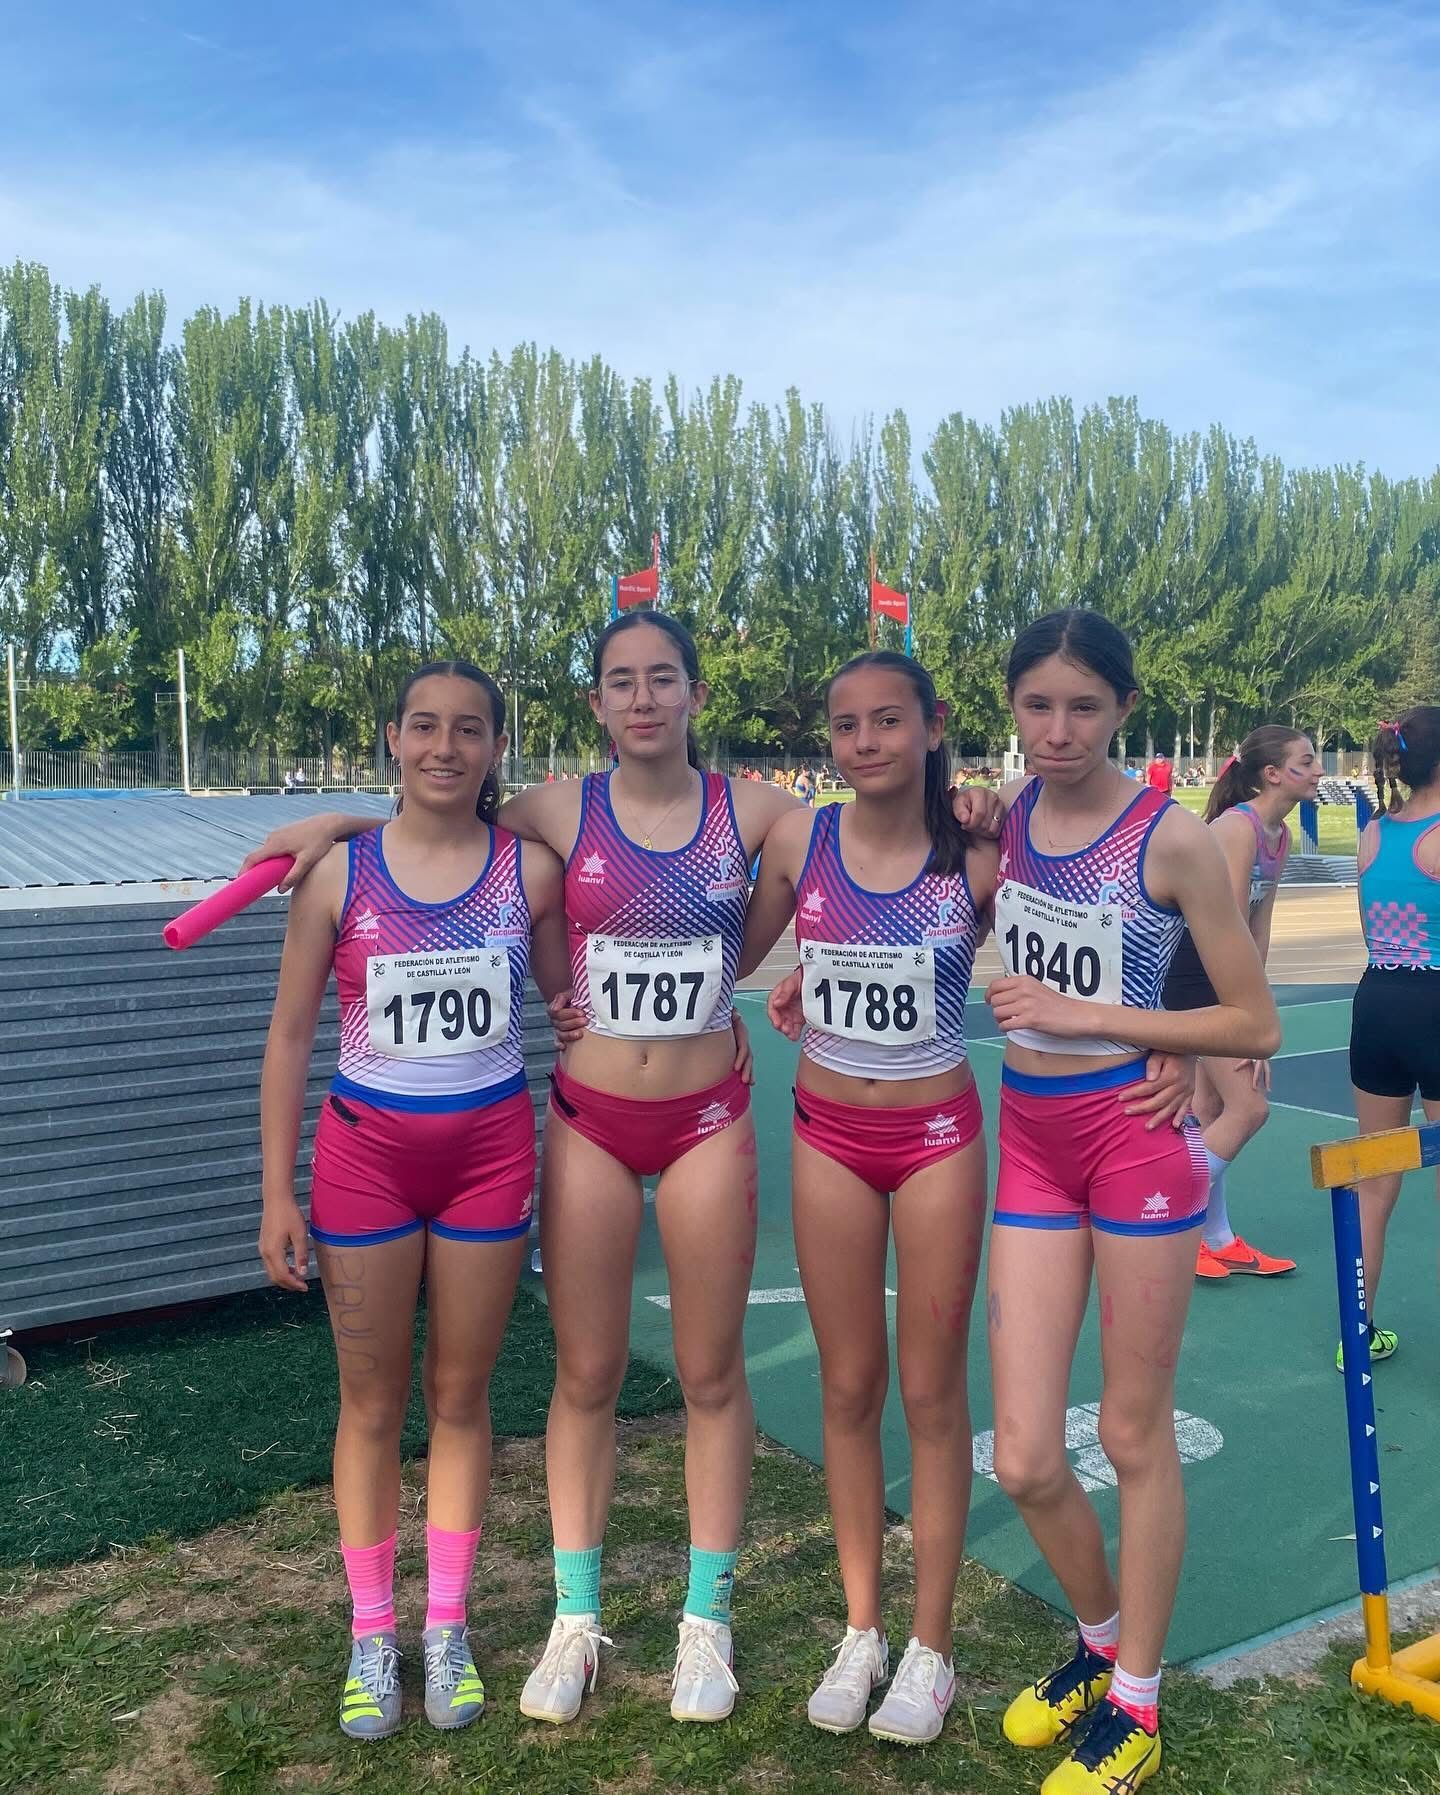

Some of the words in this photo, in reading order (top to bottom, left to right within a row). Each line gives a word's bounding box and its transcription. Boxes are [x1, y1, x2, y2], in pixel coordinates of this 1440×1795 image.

[577, 875, 605, 885] luanvi
[1017, 890, 1047, 909] FEDERACIÓN
[1047, 902, 1054, 911] DE
[1054, 906, 1088, 919] ATLETISMO
[1023, 905, 1031, 913] DE
[1031, 907, 1055, 923] CASTILLA
[1061, 919, 1078, 929] LEÓN
[613, 940, 649, 948] FEDERACIÓN
[659, 940, 692, 948] ATLETISMO
[633, 951, 661, 959] CASTILLA
[667, 950, 683, 958] LEÓN
[821, 948, 858, 958] FEDERACIÓN
[868, 951, 903, 959] ATLETISMO
[1005, 923, 1101, 997] 1840
[394, 958, 434, 968] FEDERACIÓN
[435, 957, 445, 965] DE
[445, 955, 480, 964] ATLETISMO
[832, 959, 841, 967] DE
[841, 960, 870, 969] CASTILLA
[877, 960, 894, 970] LEÓN
[416, 969, 447, 977] CASTILLA
[454, 966, 471, 975] LEÓN
[601, 971, 705, 1022] 1787
[814, 977, 918, 1032] 1788
[384, 987, 492, 1045] 1790
[924, 1133, 961, 1147] luanvi
[1141, 1211, 1169, 1219] luanvi
[1355, 1257, 1366, 1310] MONDO
